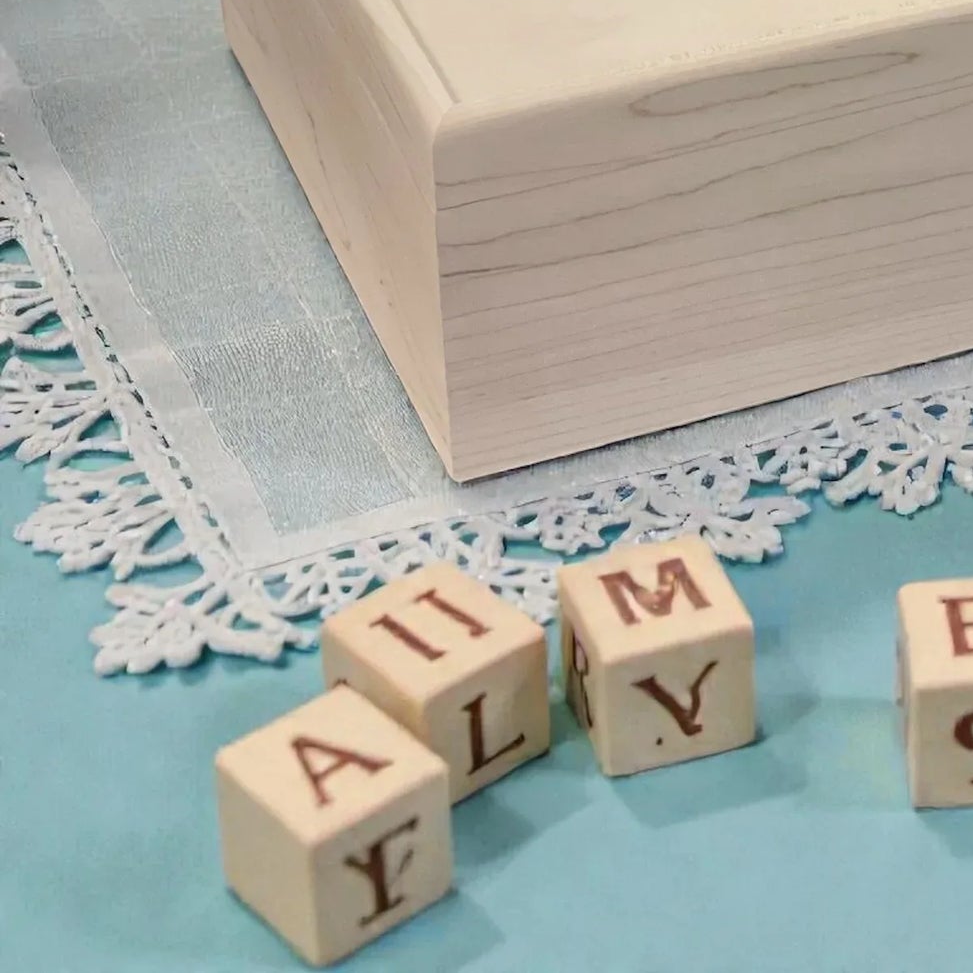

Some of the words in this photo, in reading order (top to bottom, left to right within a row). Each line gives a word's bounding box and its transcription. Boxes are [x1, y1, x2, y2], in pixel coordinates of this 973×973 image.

[597, 557, 712, 626] M
[460, 691, 525, 776] L
[291, 735, 394, 808] A
